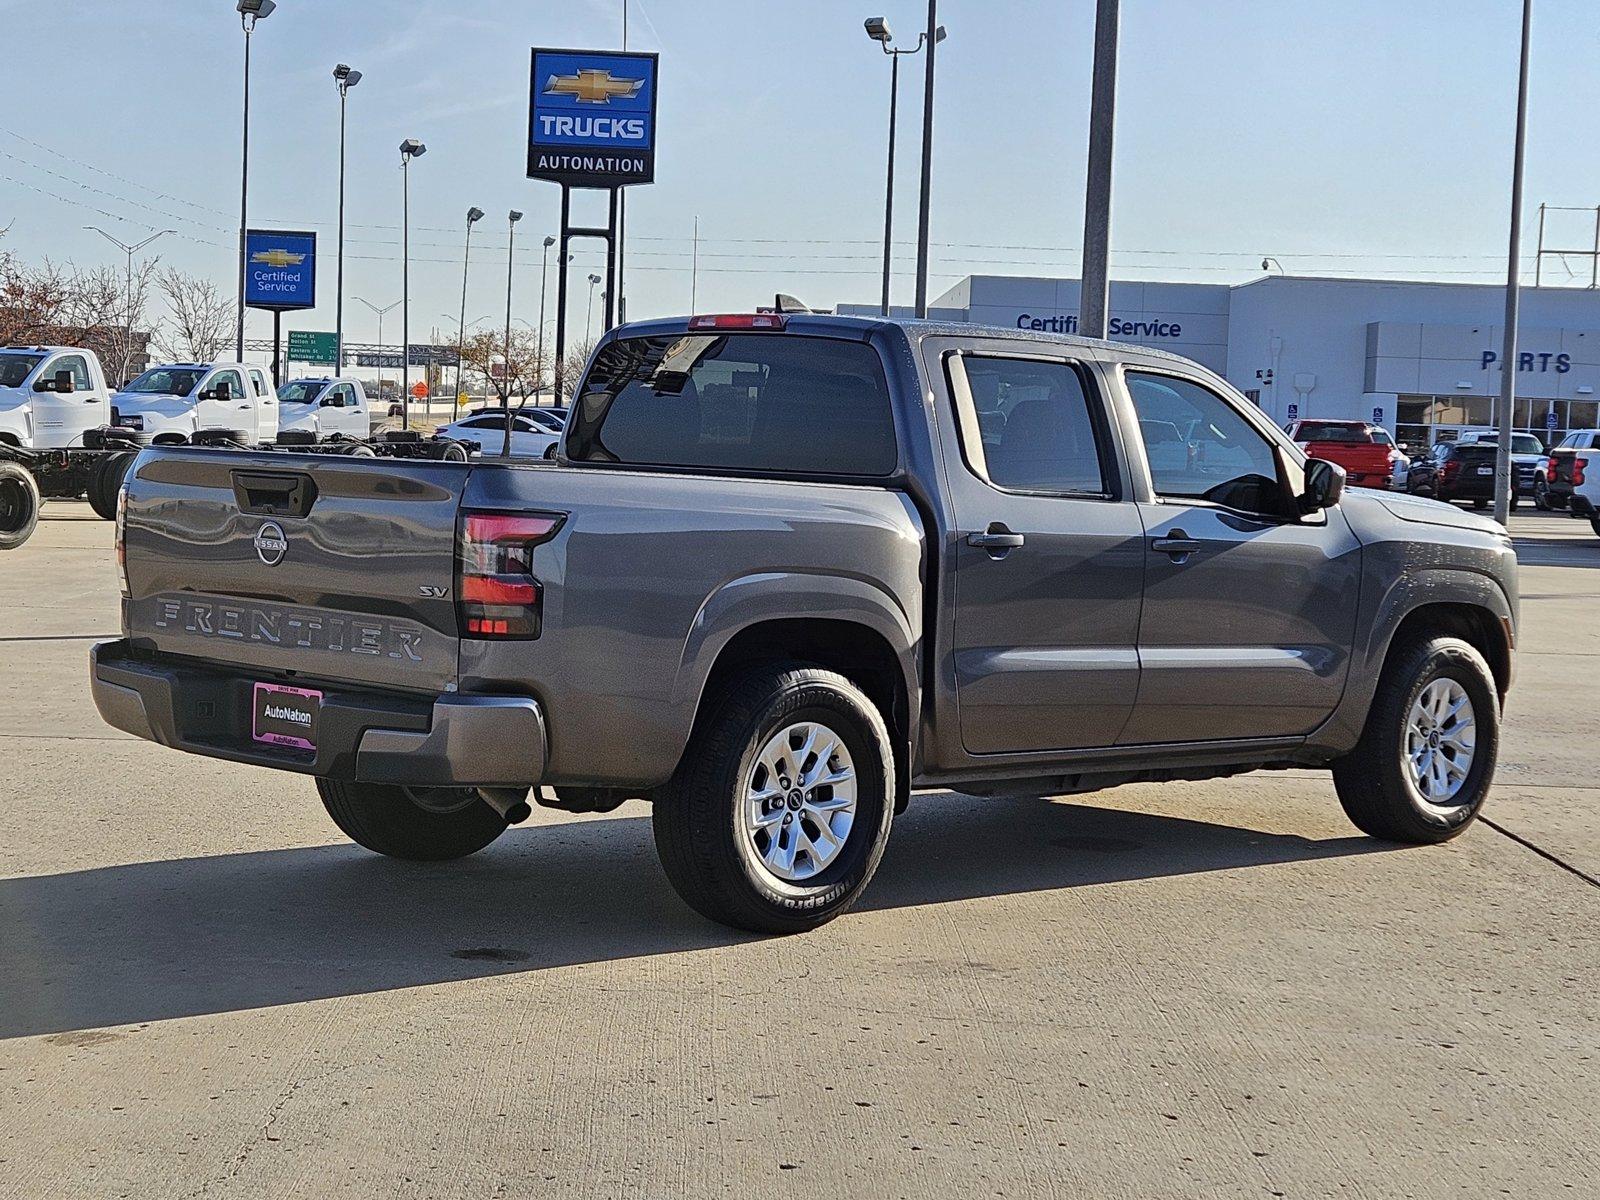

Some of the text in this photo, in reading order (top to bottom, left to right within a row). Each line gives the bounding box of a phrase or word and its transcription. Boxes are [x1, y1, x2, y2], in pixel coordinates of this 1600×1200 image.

[540, 115, 644, 139] TRUCKS
[538, 155, 644, 173] AUTONATION
[254, 271, 301, 282] Certified
[257, 281, 297, 292] Service
[1017, 313, 1182, 337] Certifi Service
[1482, 350, 1571, 374] PRTS
[254, 538, 287, 551] NISSAN
[419, 585, 449, 598] SV
[156, 598, 423, 661] FRONTIER
[264, 704, 311, 723] AutoNation
